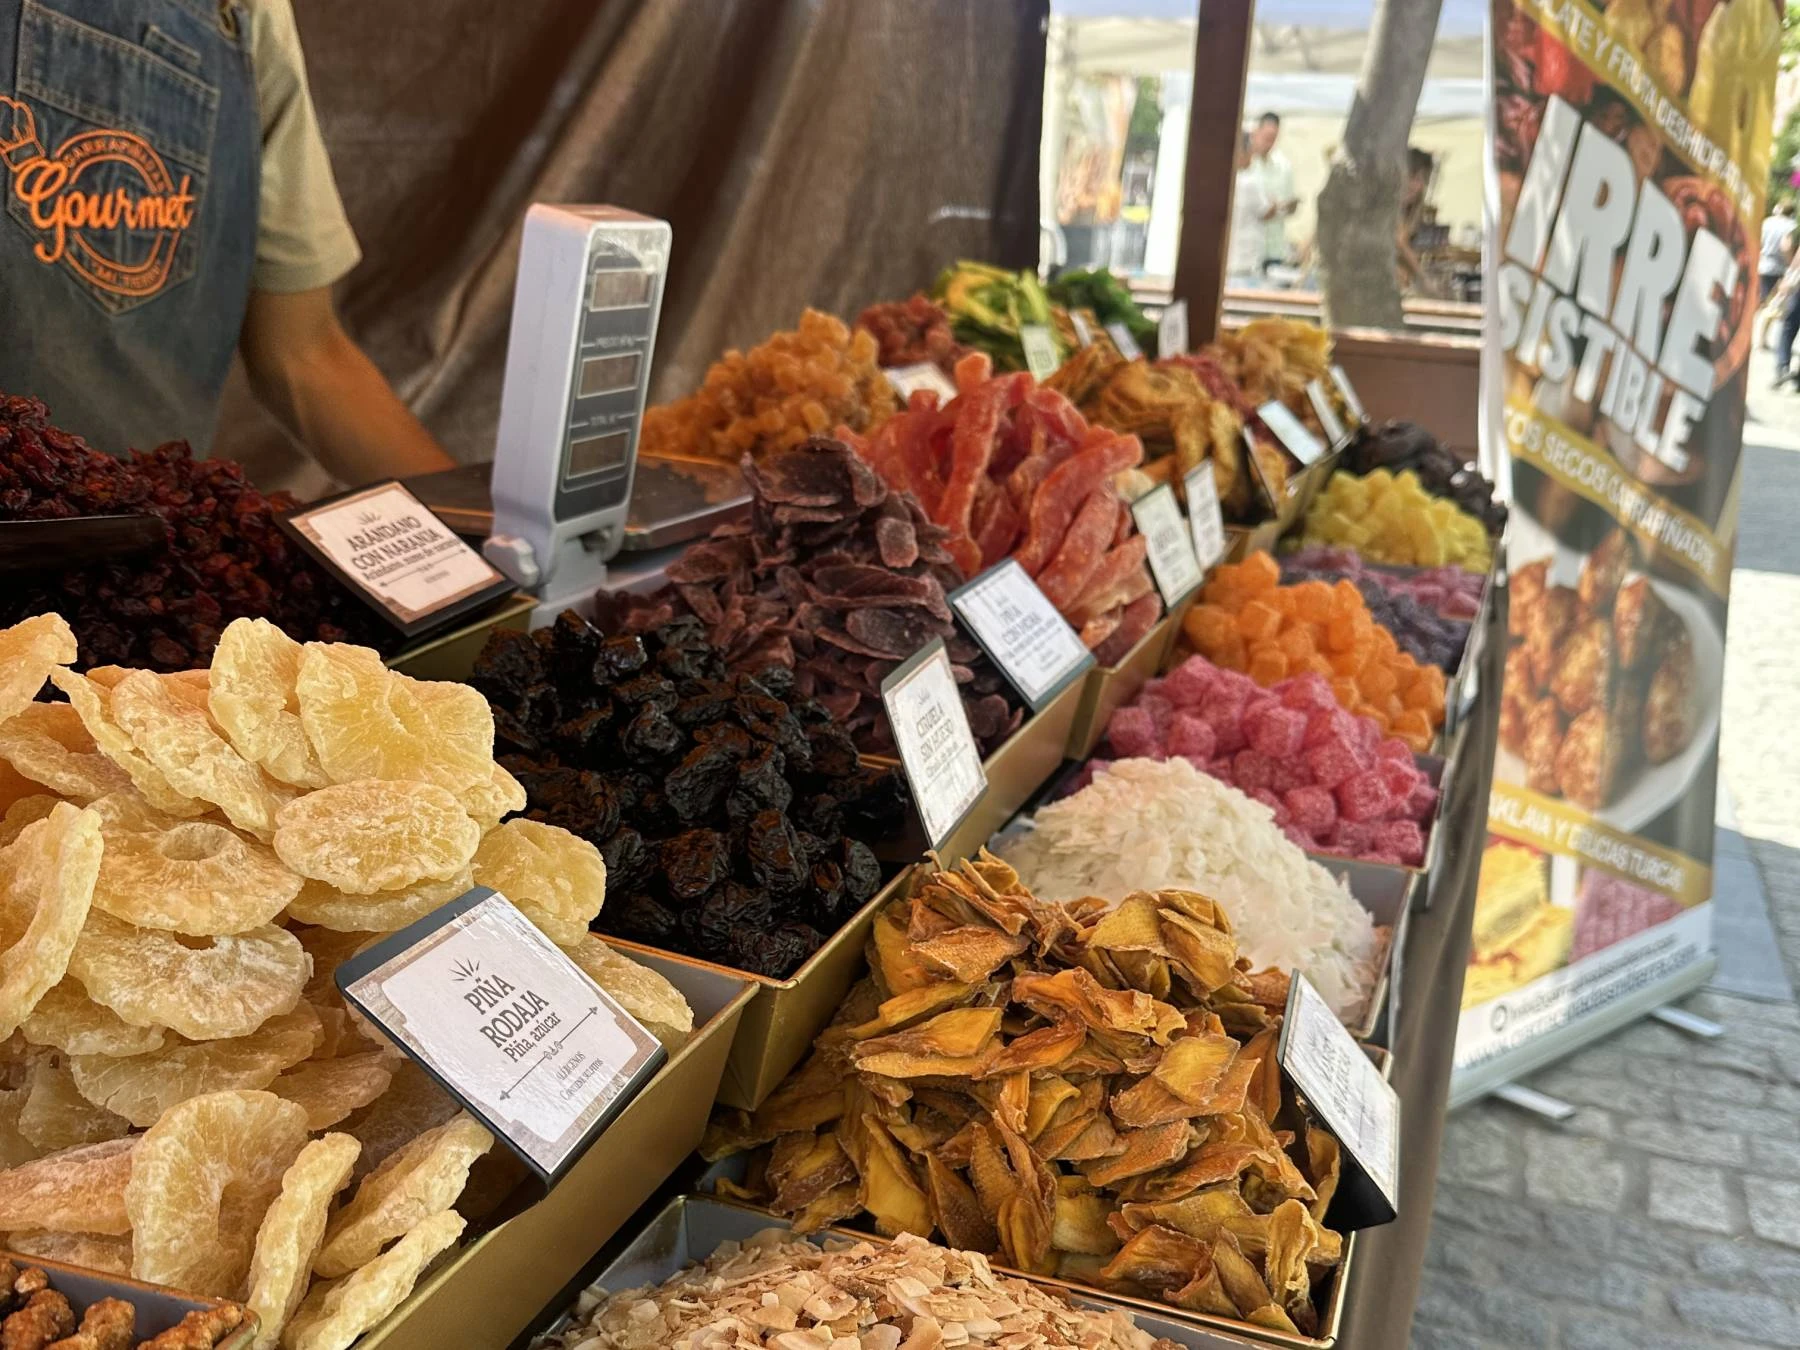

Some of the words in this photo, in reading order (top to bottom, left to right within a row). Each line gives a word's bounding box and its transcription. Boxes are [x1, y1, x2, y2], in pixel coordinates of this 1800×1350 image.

[1593, 30, 1613, 62] Y
[1608, 43, 1659, 115] FRUTA
[15, 156, 196, 264] Gourmet
[1504, 94, 1740, 402] IRRE
[1497, 260, 1707, 472] SISTIBLE
[1542, 434, 1609, 495] SECOS
[346, 515, 422, 552] ARÁNDANO
[352, 550, 384, 570] CON
[381, 528, 443, 559] NARANJA
[463, 973, 517, 1015] PIÑA
[480, 990, 550, 1048] RODAJA
[503, 1033, 537, 1063] Piña,
[533, 1010, 562, 1041] azúcar
